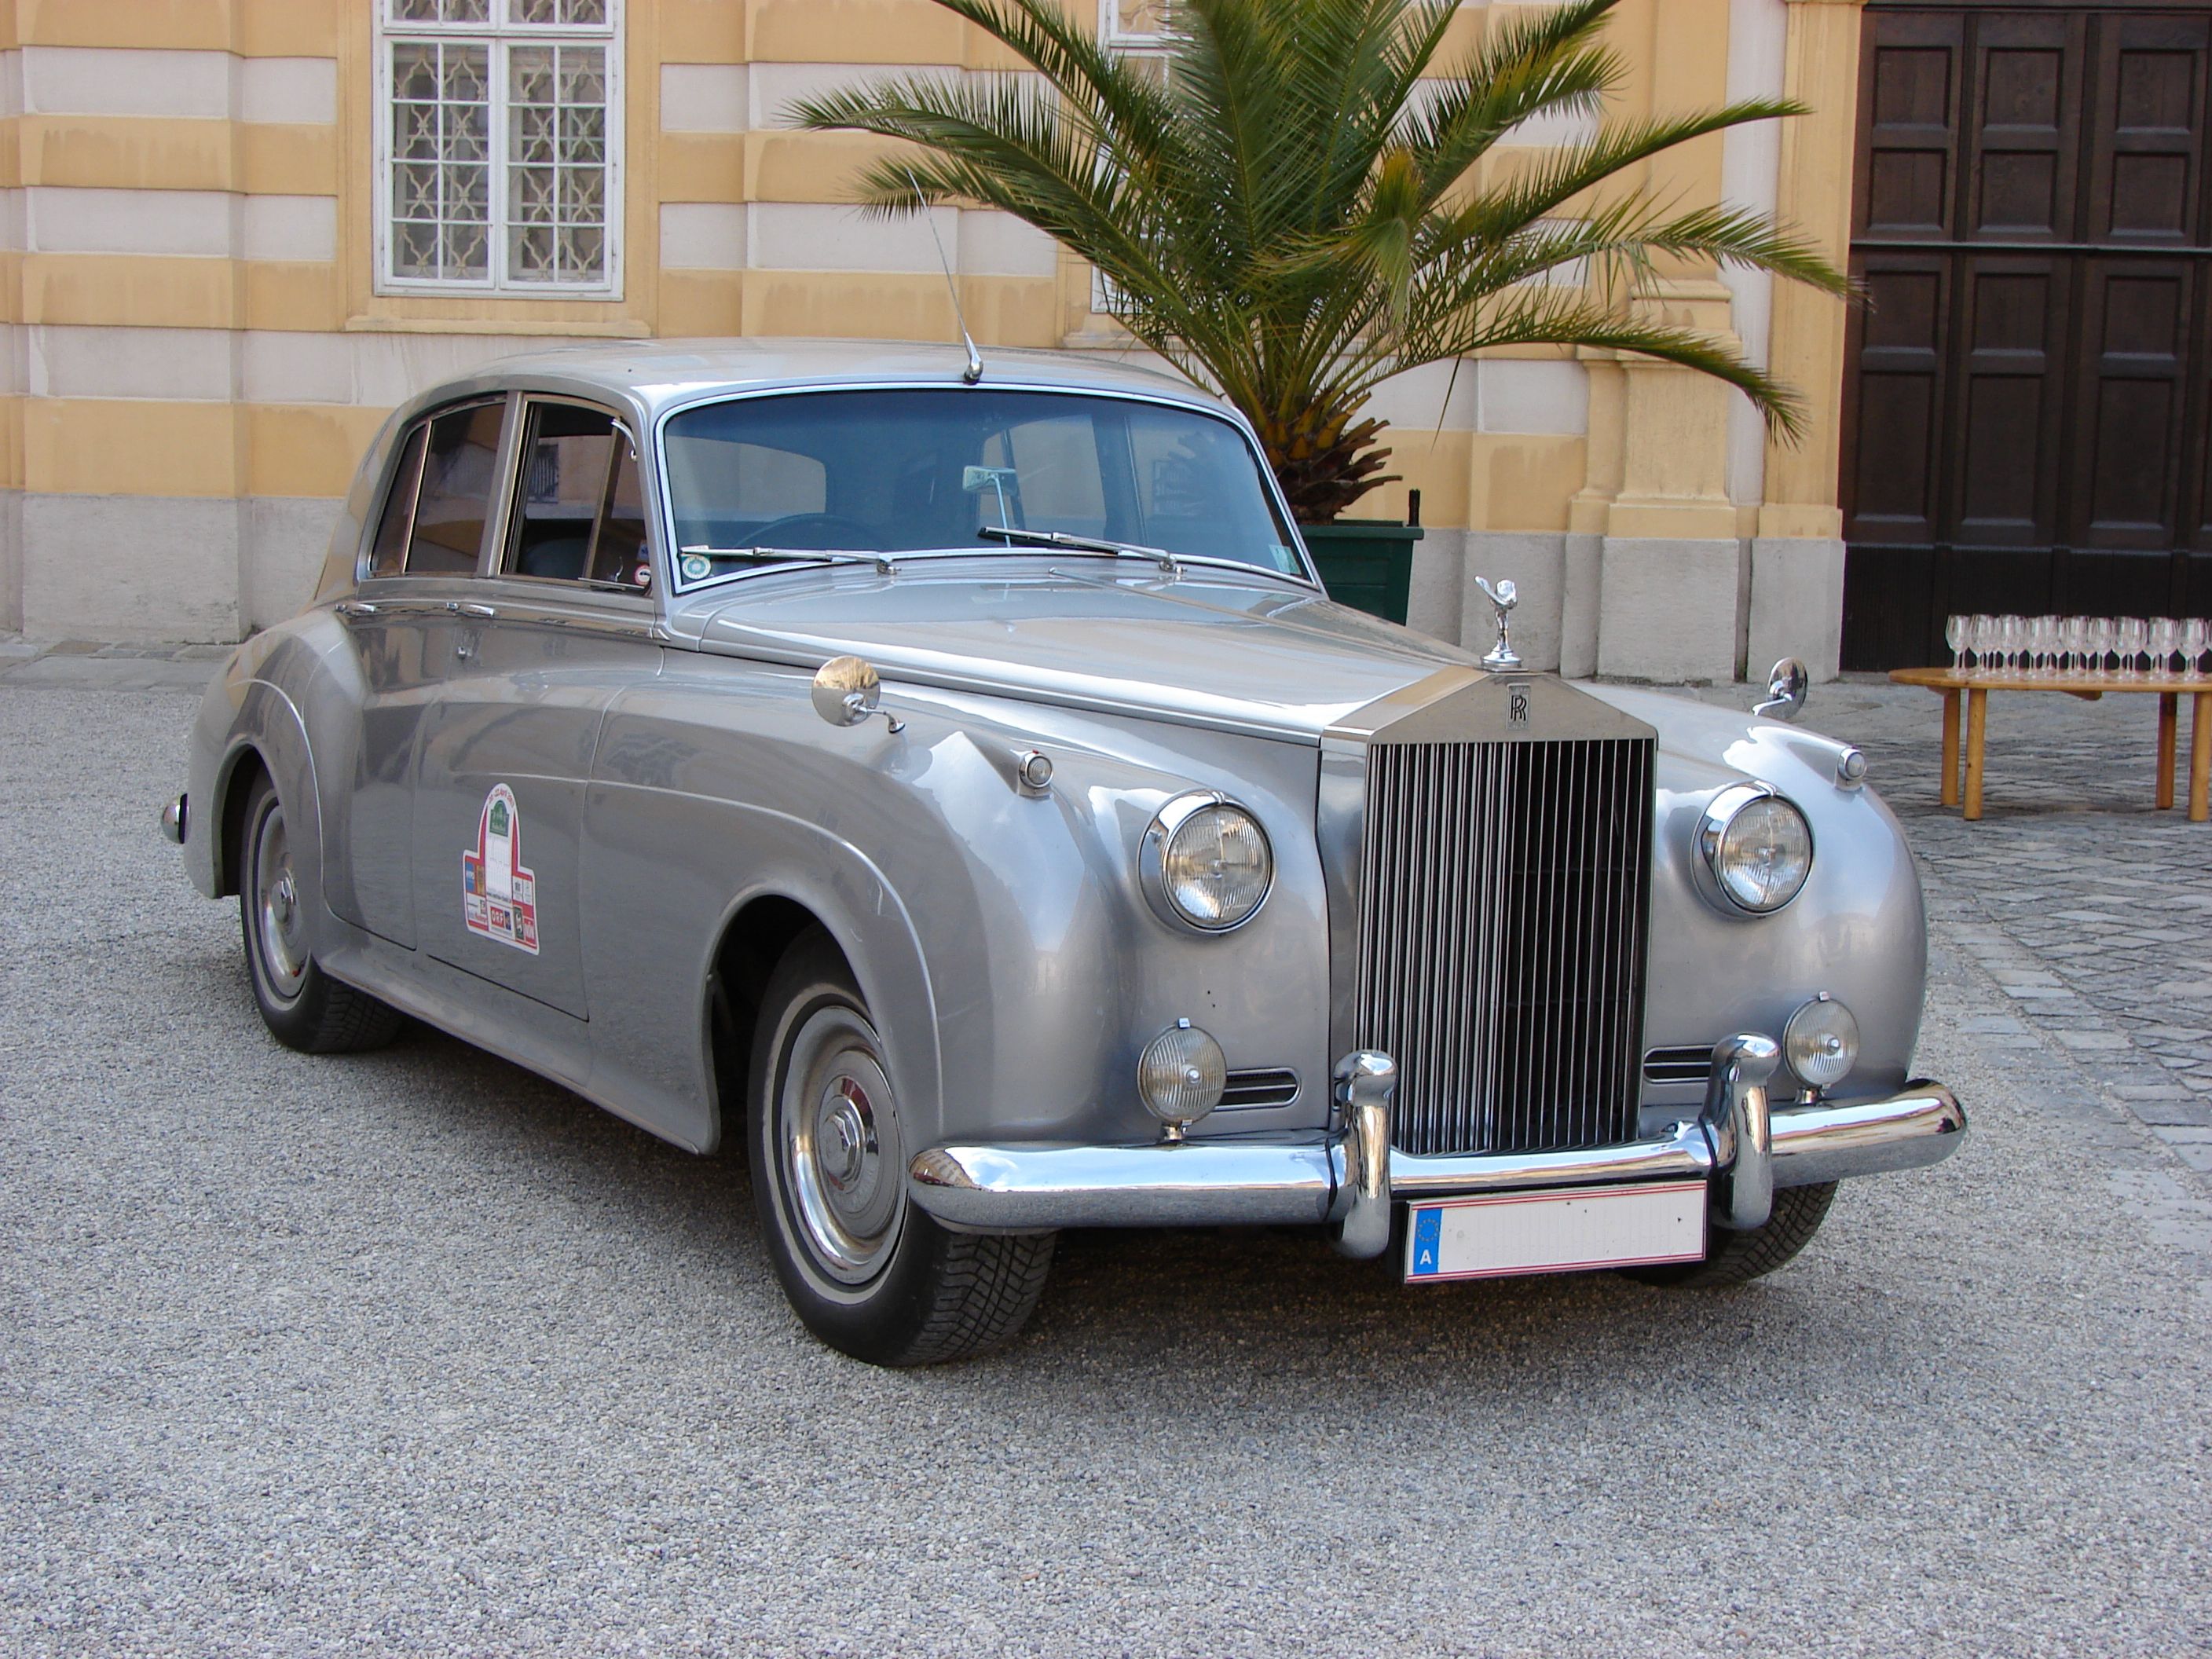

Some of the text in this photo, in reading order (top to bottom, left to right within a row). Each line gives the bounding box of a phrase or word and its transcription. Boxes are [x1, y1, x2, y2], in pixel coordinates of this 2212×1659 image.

[1511, 694, 1527, 721] RR
[491, 910, 504, 925] ORF
[1419, 1250, 1432, 1265] A
